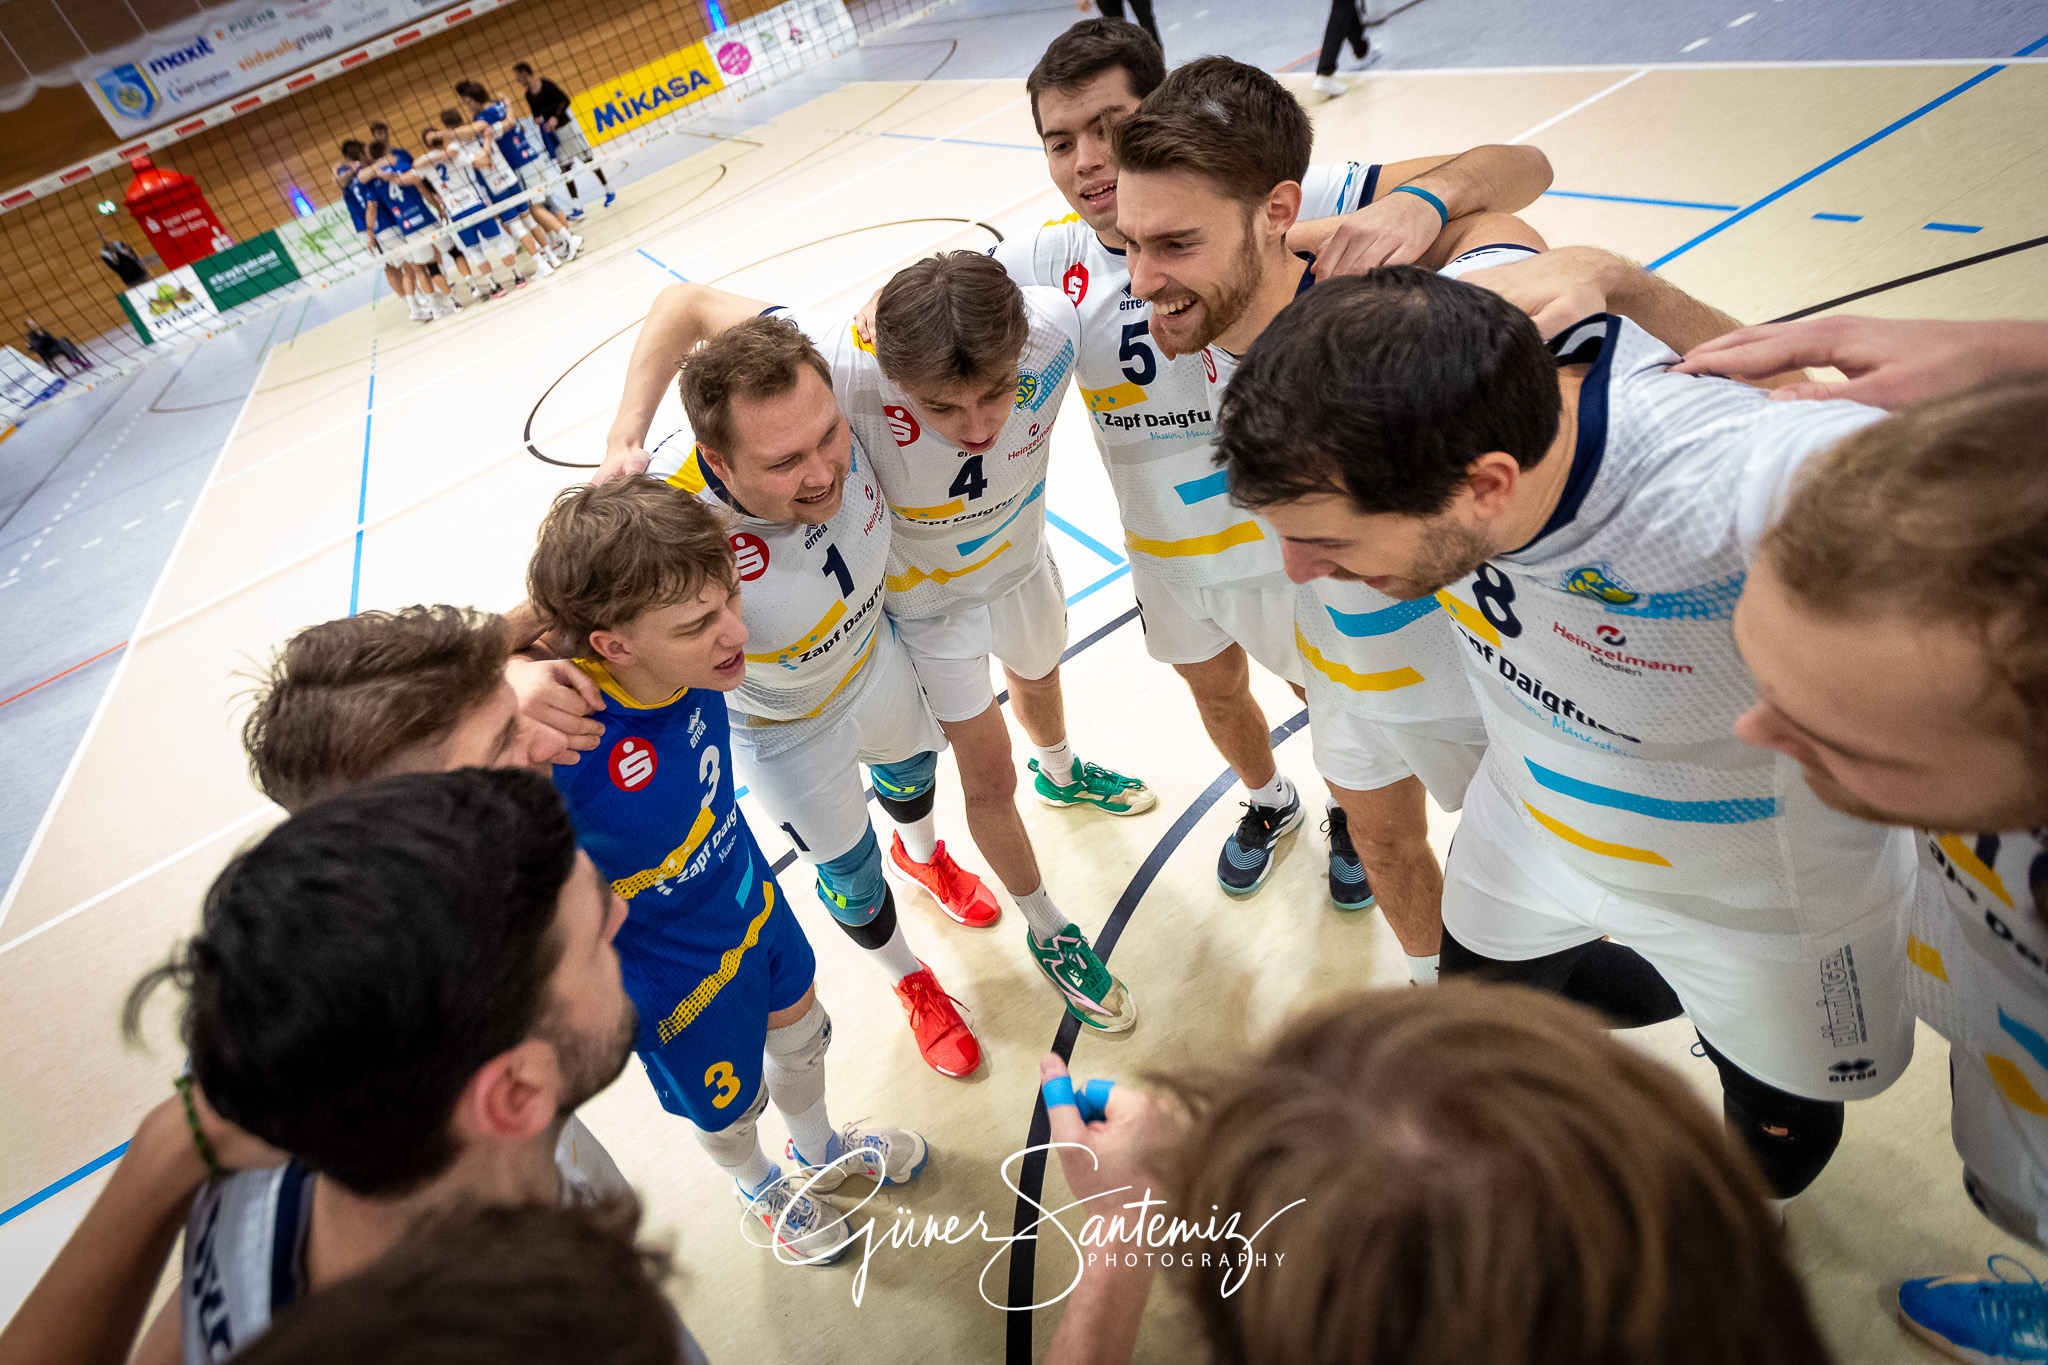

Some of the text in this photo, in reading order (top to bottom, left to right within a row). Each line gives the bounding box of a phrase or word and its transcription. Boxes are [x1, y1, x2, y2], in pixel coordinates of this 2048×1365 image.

[149, 33, 214, 76] maxit
[388, 183, 404, 202] 4
[1119, 319, 1156, 386] 5
[1103, 409, 1213, 431] Zapf Daigfu
[949, 455, 988, 501] 4
[822, 543, 855, 599] 1
[1472, 561, 1523, 638] 8
[799, 629, 840, 663] Zapf
[1553, 621, 1694, 675] Heinzelmann
[1590, 654, 1642, 677] Medien
[699, 745, 721, 809] 3
[677, 841, 711, 884] Zapf
[704, 1061, 741, 1109] 3
